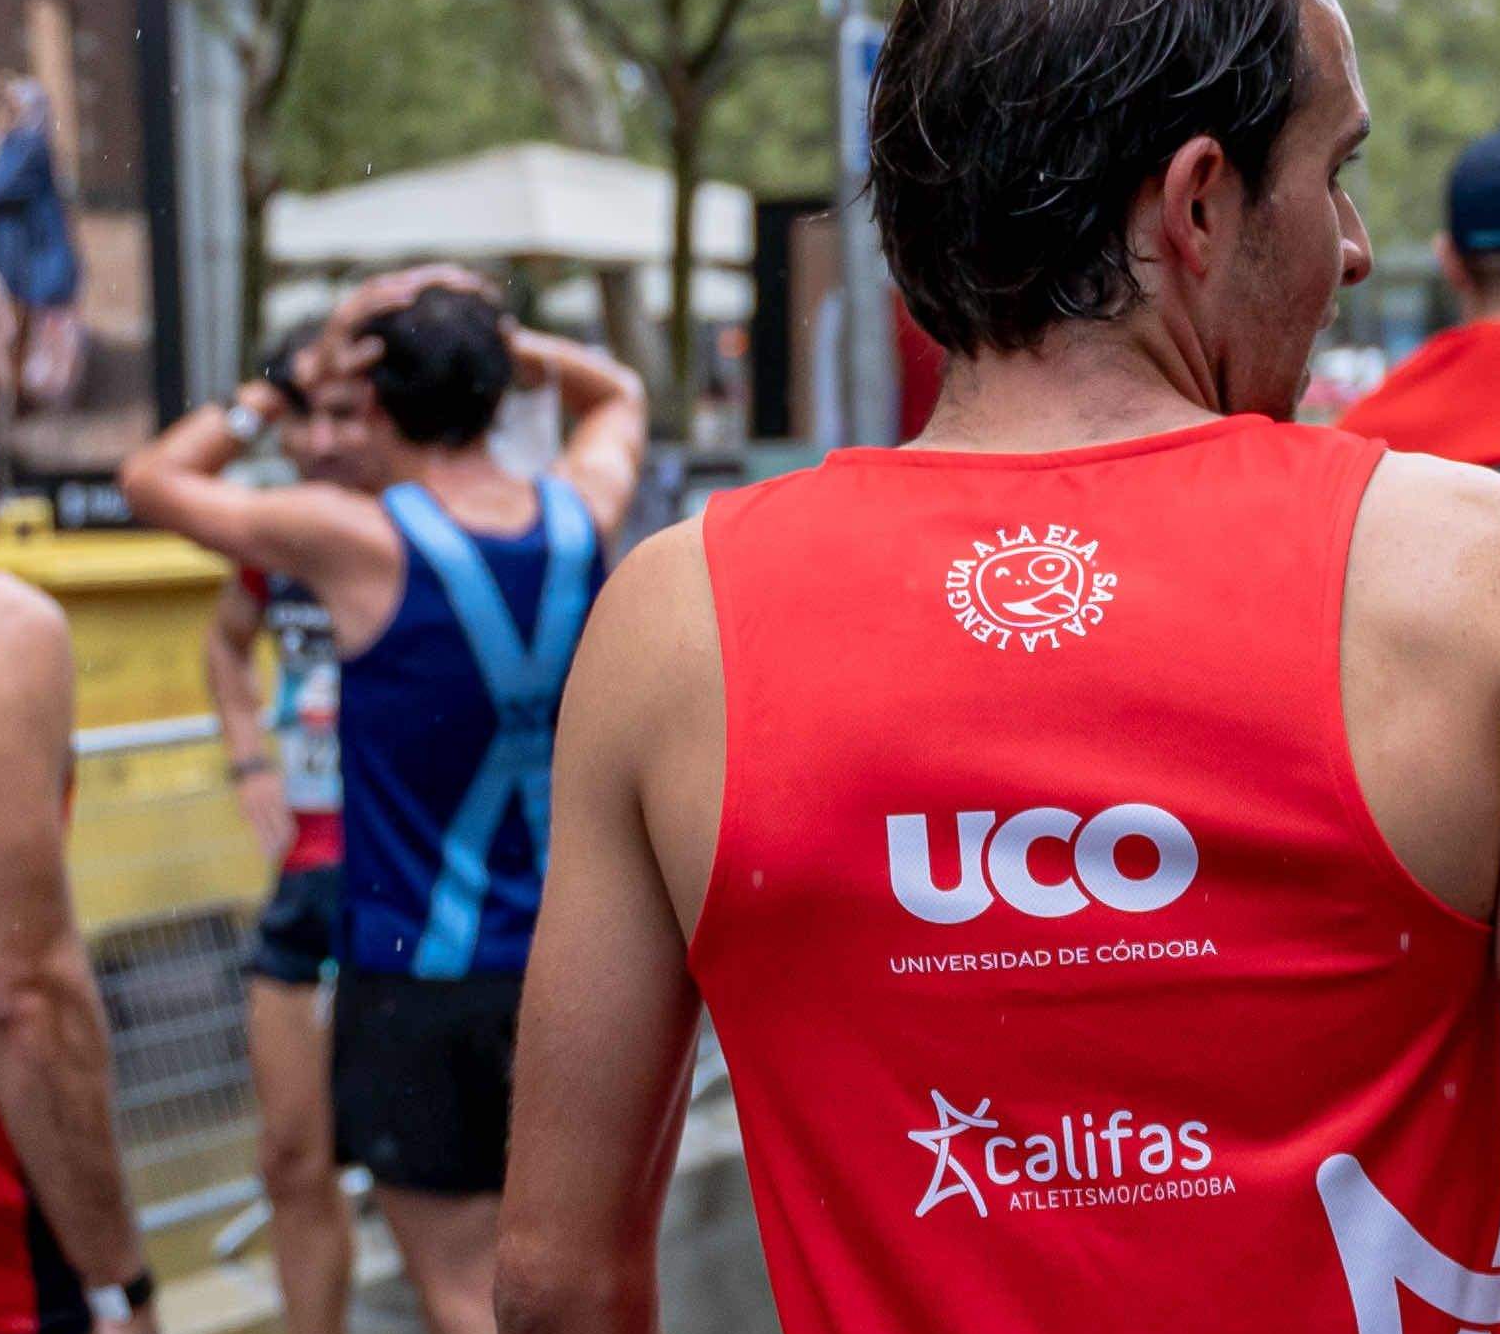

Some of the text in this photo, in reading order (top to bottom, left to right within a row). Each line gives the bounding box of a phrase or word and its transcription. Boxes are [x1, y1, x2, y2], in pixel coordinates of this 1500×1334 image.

[946, 523, 1117, 653] SACA LA LENGUA A LA ELA
[885, 803, 1199, 925] UCO
[889, 938, 1218, 974] UNIVERSIDAD DE CÓRDOBA
[985, 1110, 1213, 1185] califas
